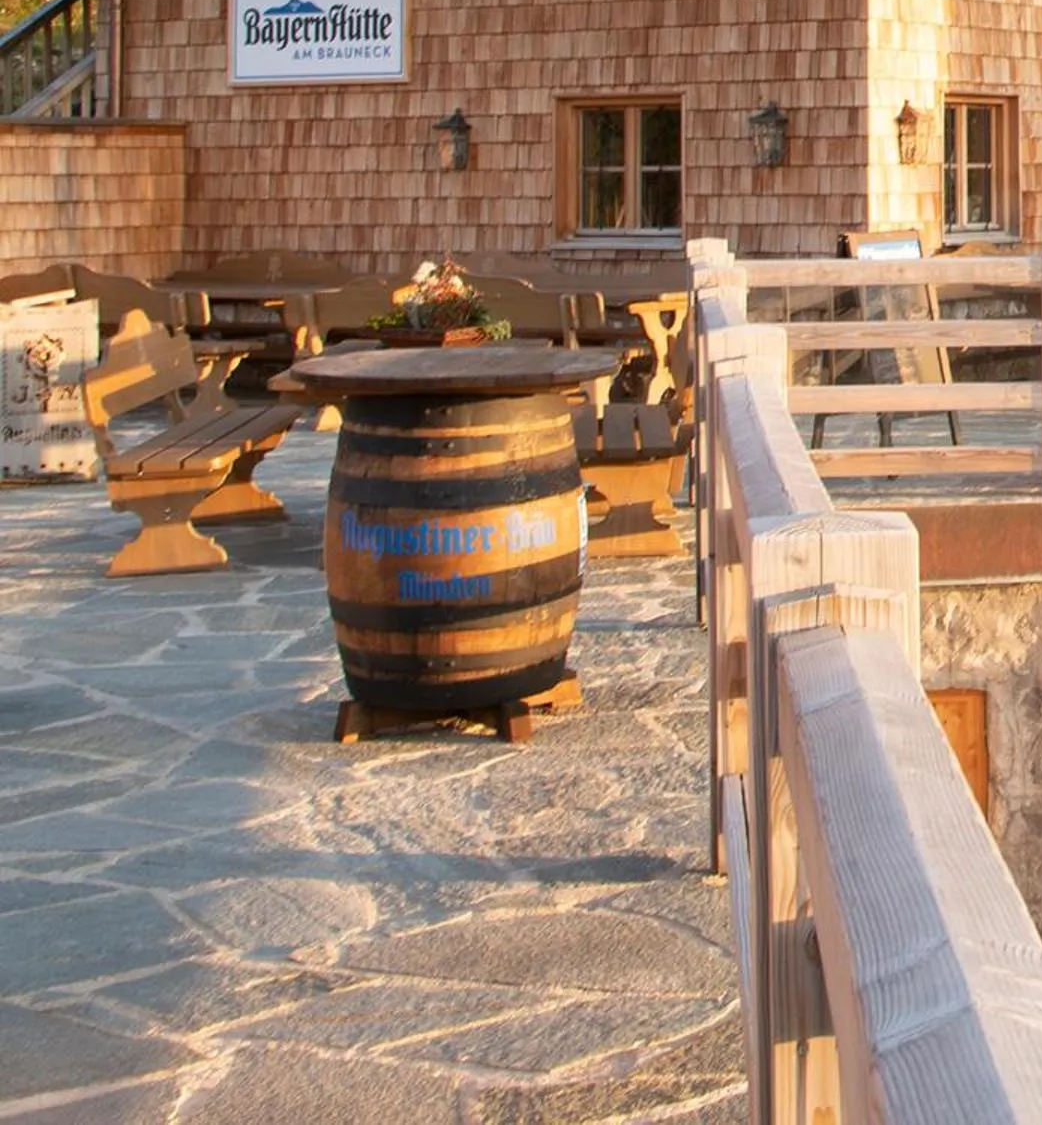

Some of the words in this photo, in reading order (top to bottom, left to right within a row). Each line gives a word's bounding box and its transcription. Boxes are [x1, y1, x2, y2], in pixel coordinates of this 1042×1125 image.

[243, 3, 393, 51] BayernHütte
[293, 49, 313, 61] AM
[317, 45, 392, 60] BRAUNECK
[398, 569, 493, 602] München
